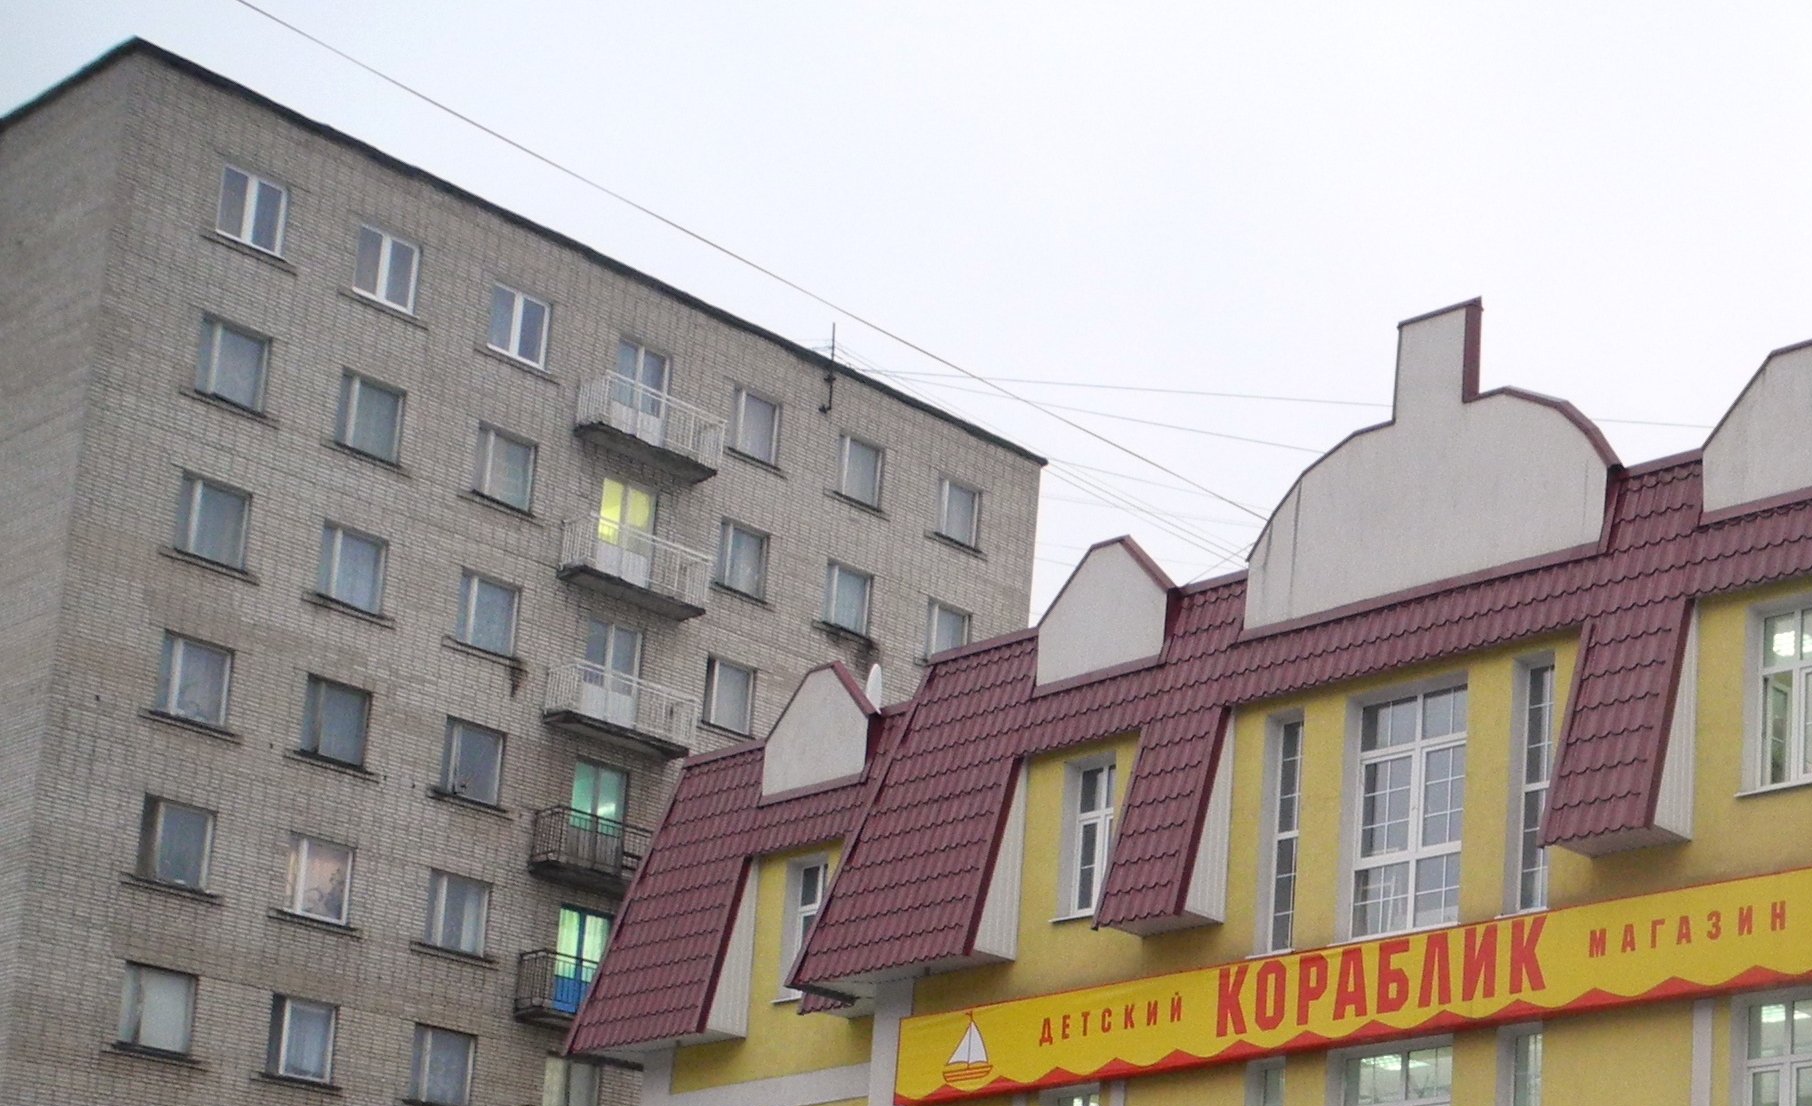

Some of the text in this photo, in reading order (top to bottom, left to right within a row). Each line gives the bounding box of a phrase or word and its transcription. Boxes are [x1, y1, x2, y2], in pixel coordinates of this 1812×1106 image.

[1039, 900, 1787, 1046] ДЕТСКИЙ КОРАБЛИК МАГАЗИН
